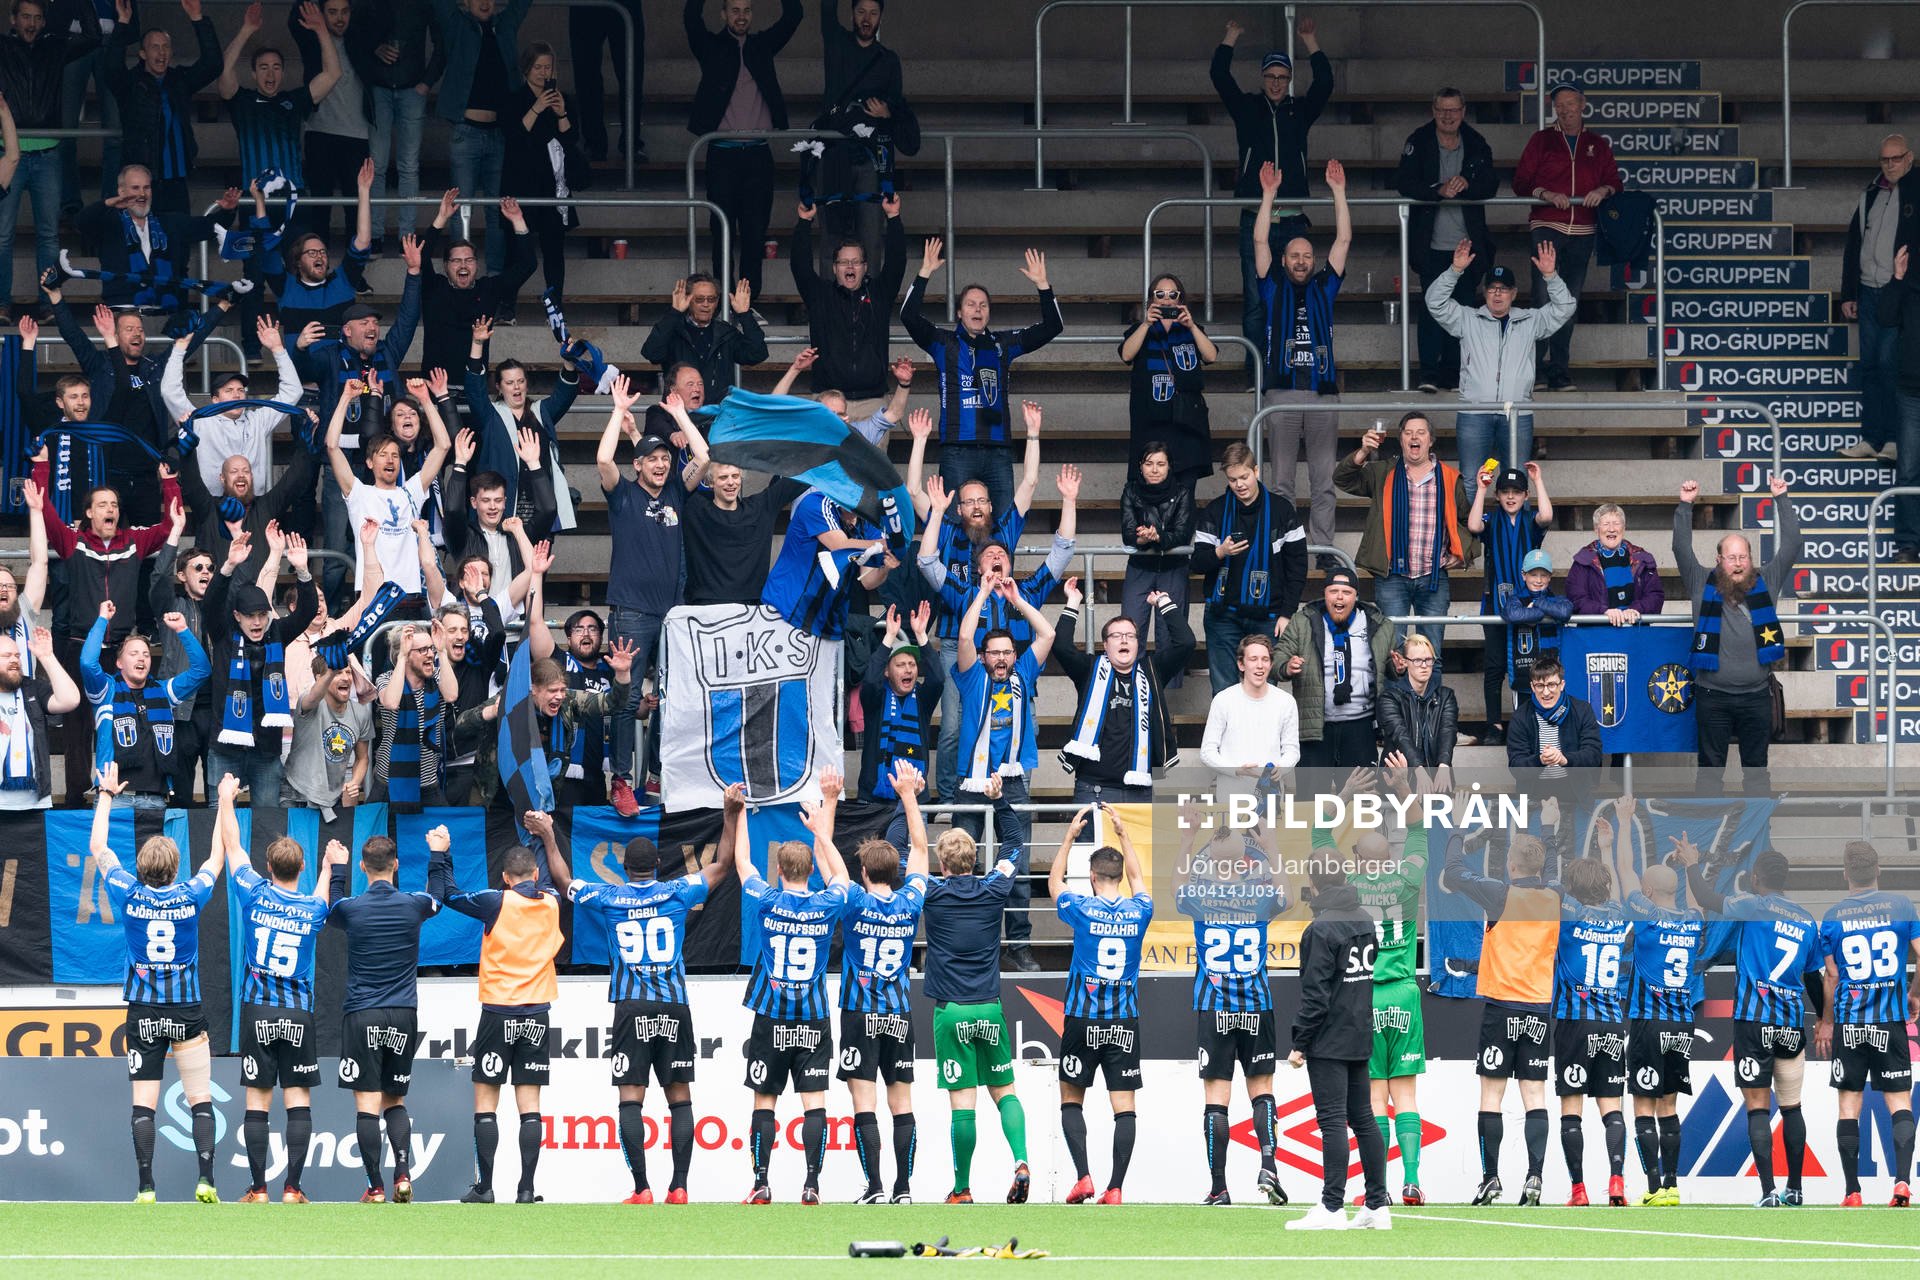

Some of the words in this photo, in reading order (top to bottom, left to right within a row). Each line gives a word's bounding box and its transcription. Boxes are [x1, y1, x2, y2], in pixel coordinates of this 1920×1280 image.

[1547, 69, 1682, 85] RO-GRUPPEN
[1581, 103, 1700, 118] O-GRUPPEN
[1618, 168, 1736, 184] O-GRUPPEN
[1672, 301, 1809, 318] RO-GRUPPEN
[1691, 334, 1828, 350] RO-GRUPPEN
[1709, 368, 1848, 385] RO-GRUPPEN
[1589, 656, 1625, 671] SIRIUS
[1361, 893, 1397, 905] WICKS
[126, 904, 196, 920] BJÖRKSTRÖM
[628, 907, 658, 919] OGBU
[1204, 913, 1257, 925] HASLUND
[1836, 907, 1864, 918] ÅRSTA
[1873, 902, 1892, 911] TAK
[251, 910, 312, 935] LUNDHOLM
[763, 917, 829, 935] GUSTAFSSON
[853, 921, 914, 938] ARVIDSSON
[1089, 922, 1138, 936] EDDAHRI
[1774, 921, 1806, 942] RAZAK
[1842, 914, 1891, 932] MAHOLLI
[146, 920, 176, 962] 8
[616, 916, 675, 964] 90
[1573, 927, 1627, 943] BJÖRNSTRÖ
[1659, 933, 1696, 947] LARSON
[254, 927, 301, 977] 15
[769, 934, 816, 981] 19
[860, 937, 904, 978] 18
[1096, 937, 1127, 979] 9
[1204, 928, 1260, 972] 23
[1768, 936, 1800, 983] 7
[1841, 930, 1898, 981] 93
[1581, 942, 1620, 988] 16
[1663, 947, 1689, 987] 3
[255, 1019, 304, 1047] bjerking
[635, 1014, 679, 1042] bjerking
[1086, 1024, 1134, 1053] bjerking
[1842, 1024, 1889, 1053] bjerking
[231, 1115, 446, 1182] Synciy
